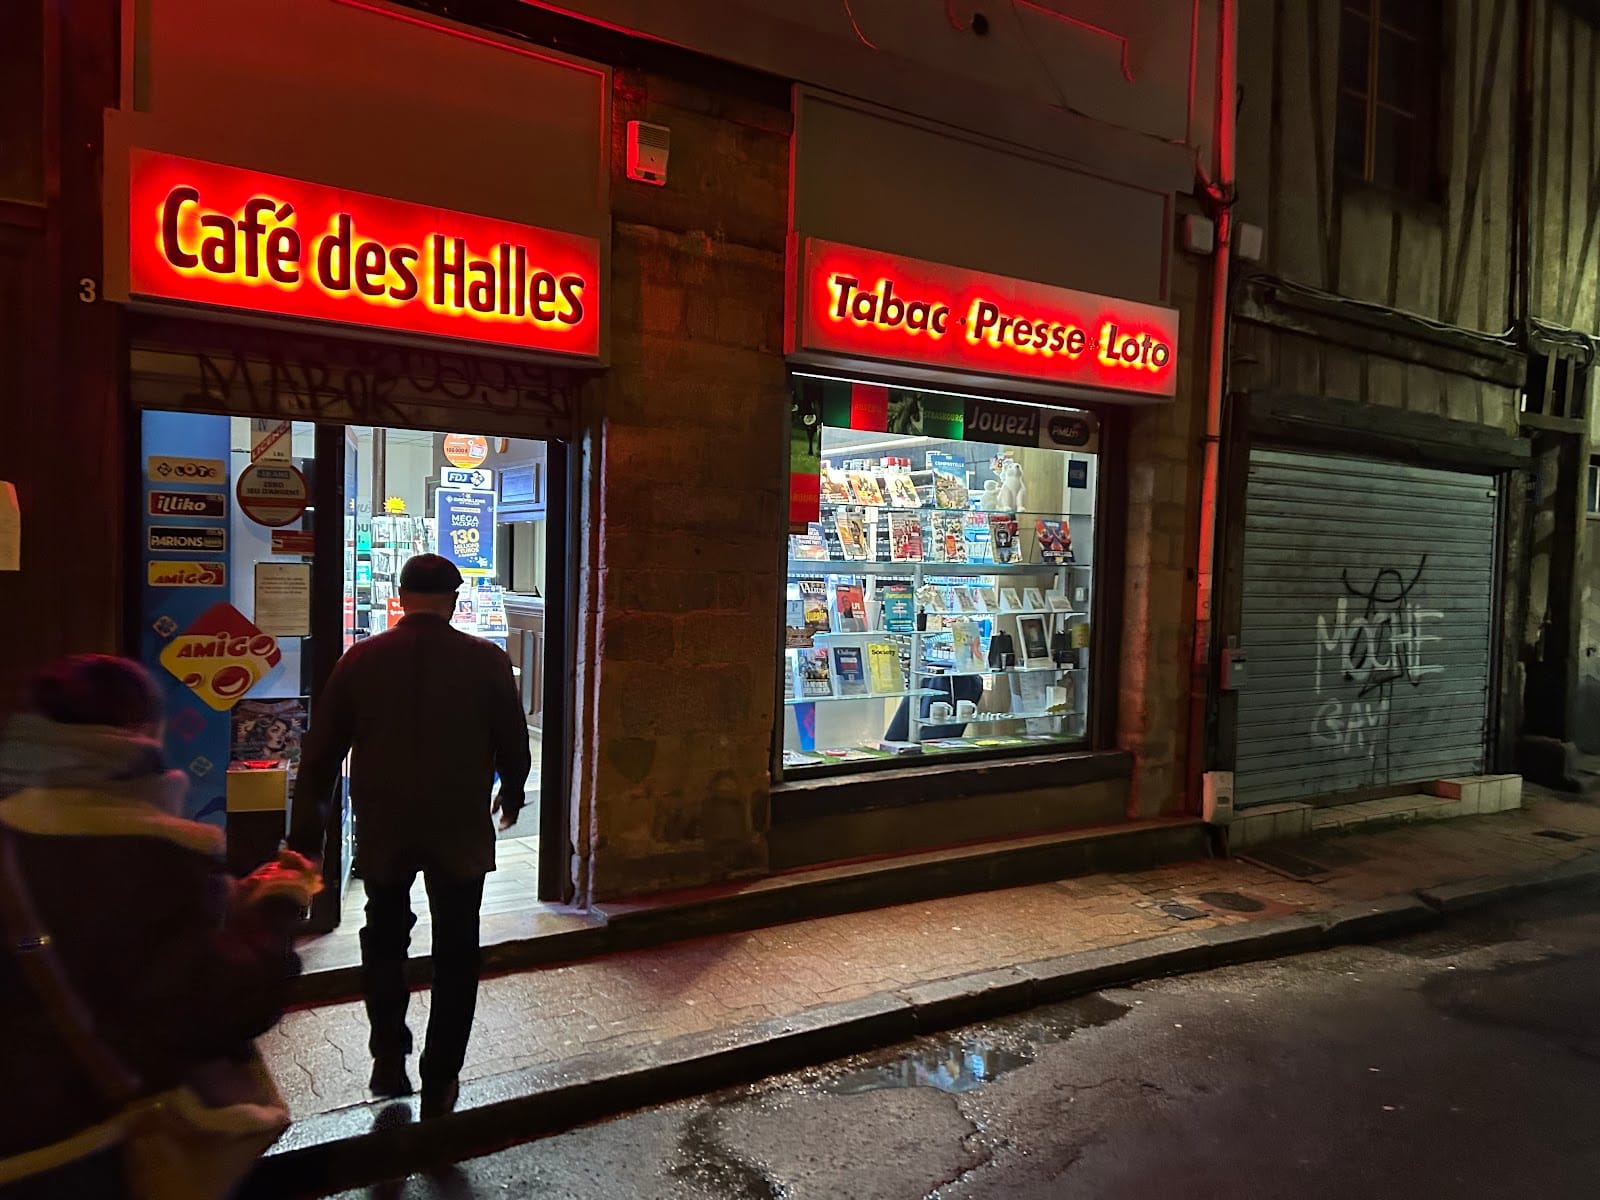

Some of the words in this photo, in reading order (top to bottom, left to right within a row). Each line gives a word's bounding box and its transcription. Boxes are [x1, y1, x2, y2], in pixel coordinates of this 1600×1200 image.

[163, 186, 300, 283] Café
[318, 213, 419, 301] des
[432, 234, 585, 325] Halles
[79, 278, 96, 303] 3
[833, 274, 950, 334] Tabac
[974, 298, 1086, 355] Presse
[1106, 323, 1170, 368] Loto
[968, 406, 1036, 437] Jouez!
[448, 473, 467, 482] FDJ
[157, 495, 206, 513] illiko
[150, 536, 203, 547] PARIONS
[450, 528, 480, 545] 130
[871, 649, 896, 657] Society
